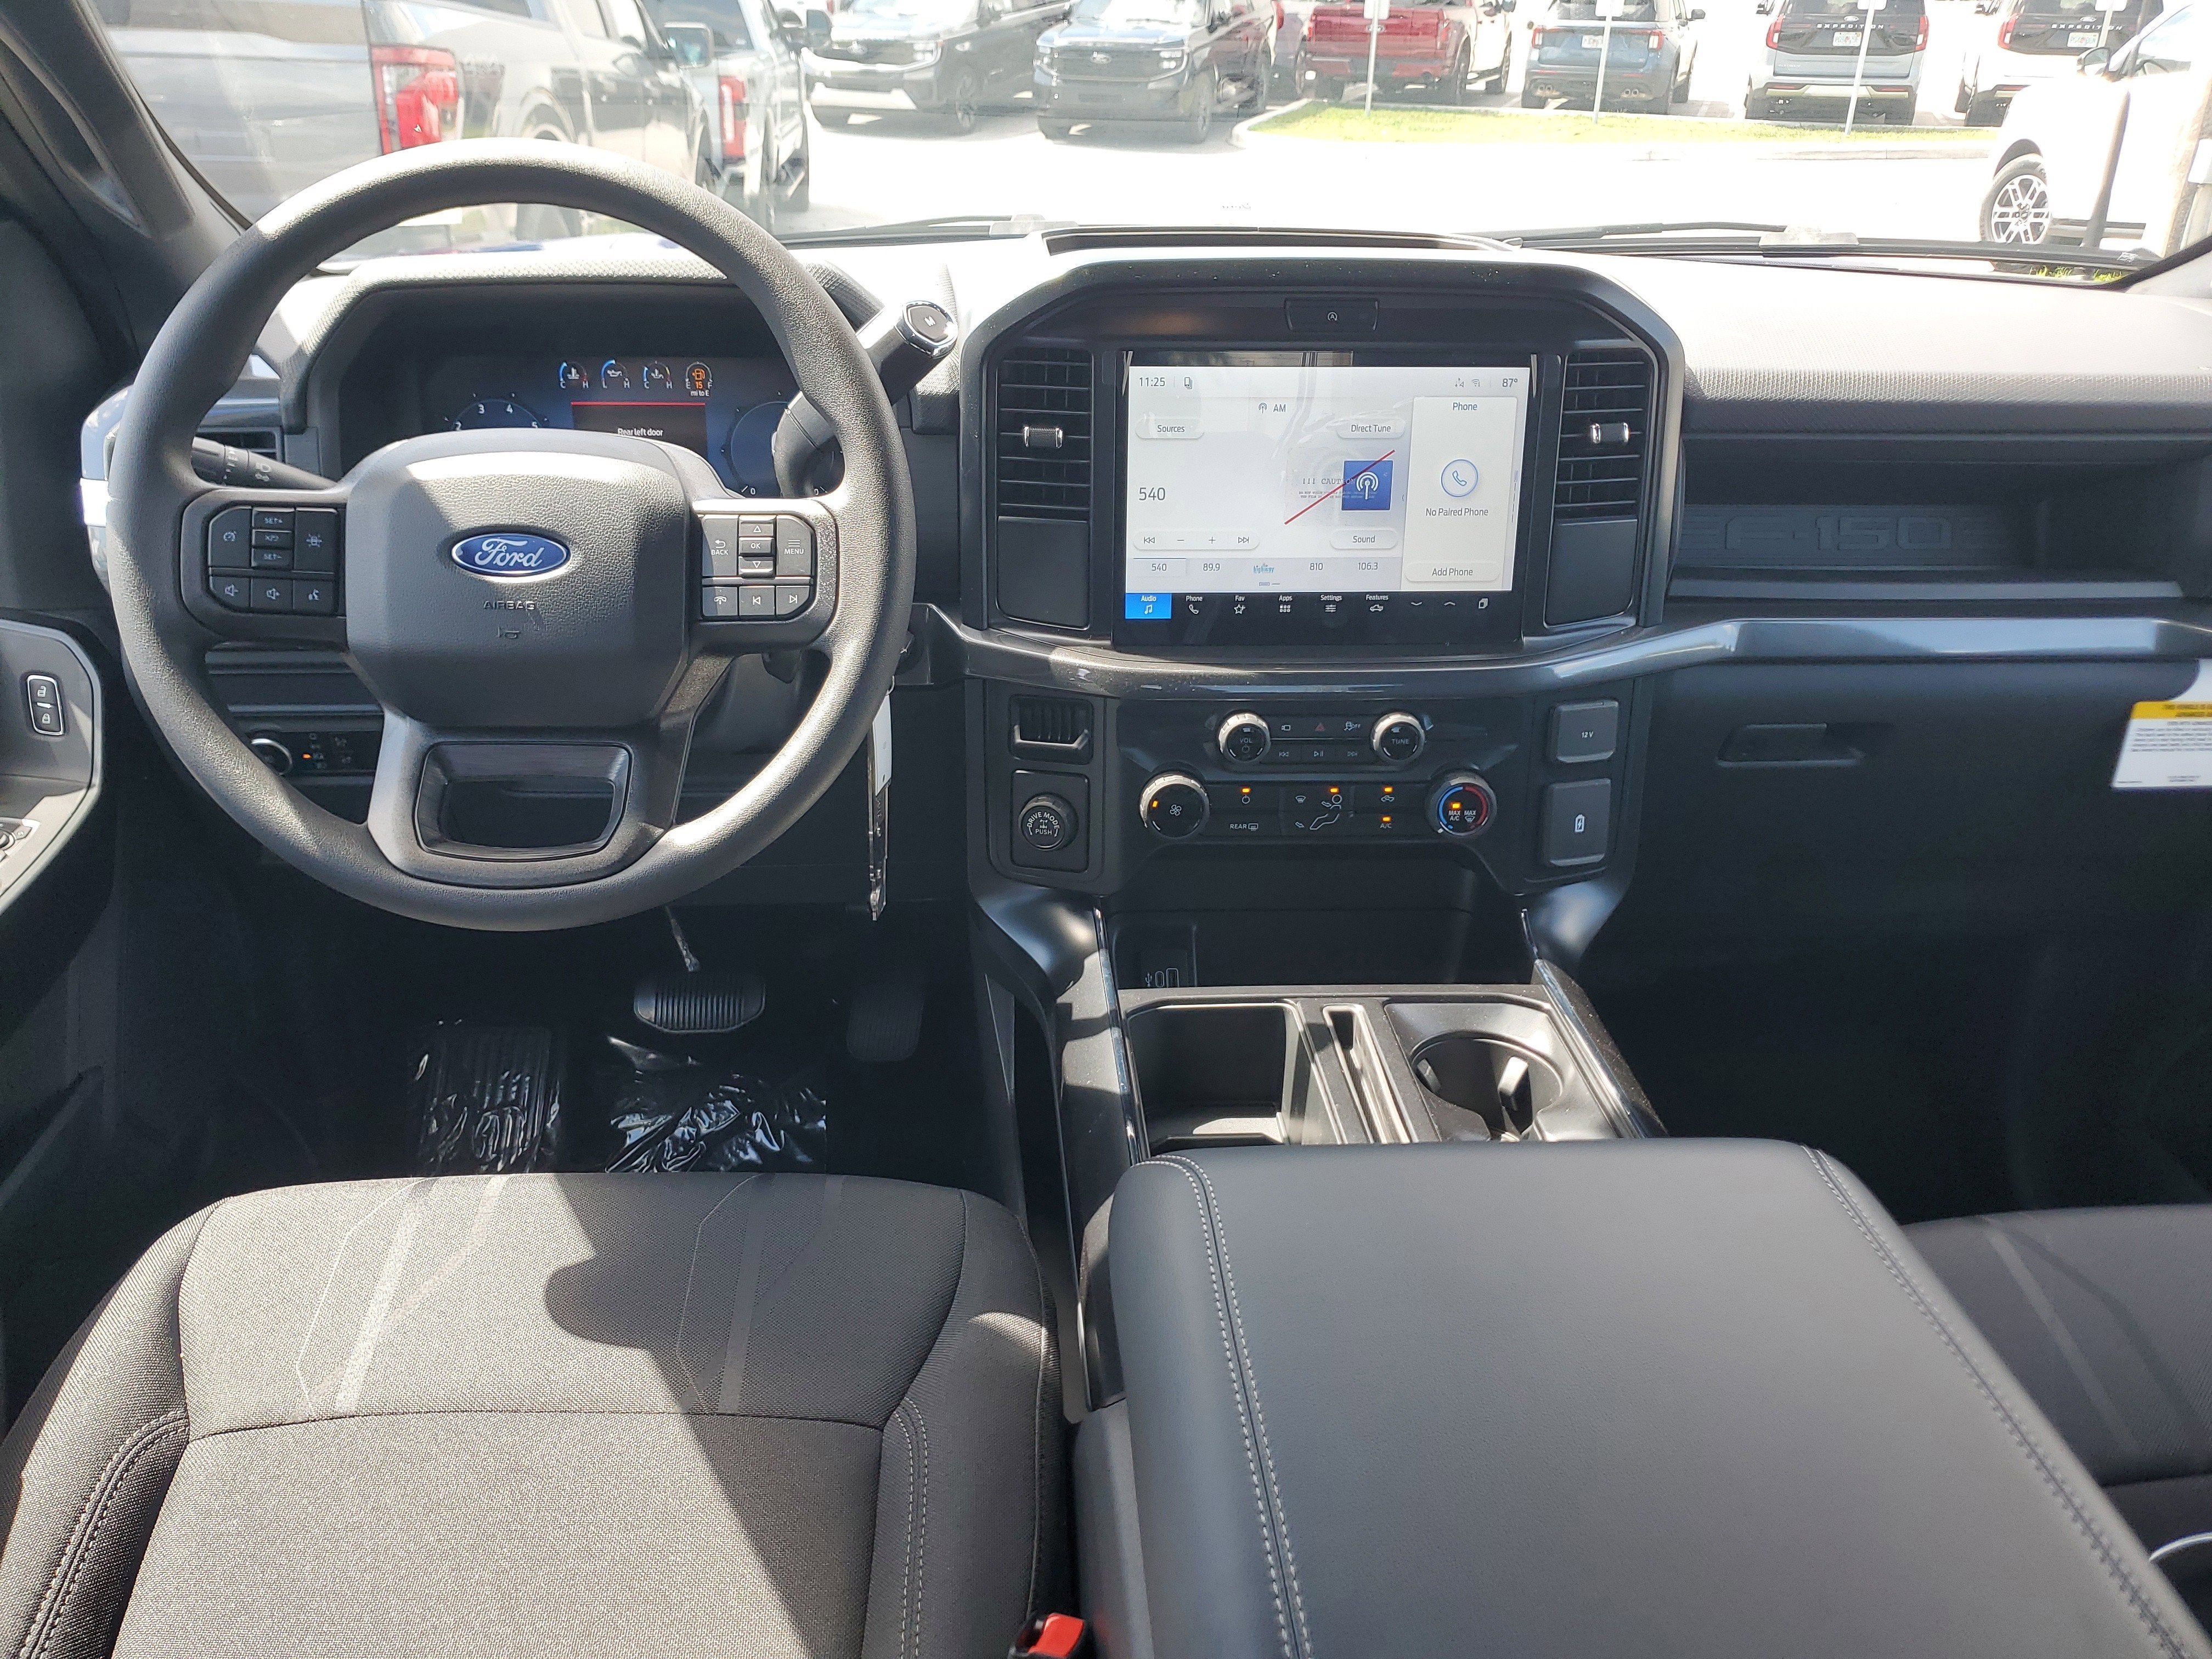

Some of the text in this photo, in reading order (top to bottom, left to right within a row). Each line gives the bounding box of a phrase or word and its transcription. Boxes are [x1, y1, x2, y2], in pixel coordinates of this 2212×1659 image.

[1139, 376, 1166, 387] 11:25
[1502, 378, 1518, 387] 87°
[478, 403, 485, 414] 3
[506, 404, 514, 414] 4
[1272, 404, 1286, 412] AM
[1452, 402, 1478, 411] Phone
[618, 427, 663, 436] Rear left door
[1351, 424, 1391, 433] Direct Tune
[1139, 487, 1166, 501] 540
[1426, 507, 1488, 517] No Paired Phone
[1352, 534, 1375, 544] Sound
[475, 538, 545, 567] Ford
[1152, 563, 1167, 572] 540
[1203, 563, 1221, 572] 89.9
[1253, 565, 1274, 574] highway
[1310, 562, 1323, 571] 810
[1358, 562, 1378, 571] 106.3
[1432, 567, 1473, 577] Add Phone
[1320, 594, 1342, 602] Settings
[483, 601, 535, 610] AIRBAG
[1027, 812, 1060, 830] DRIVE MODE
